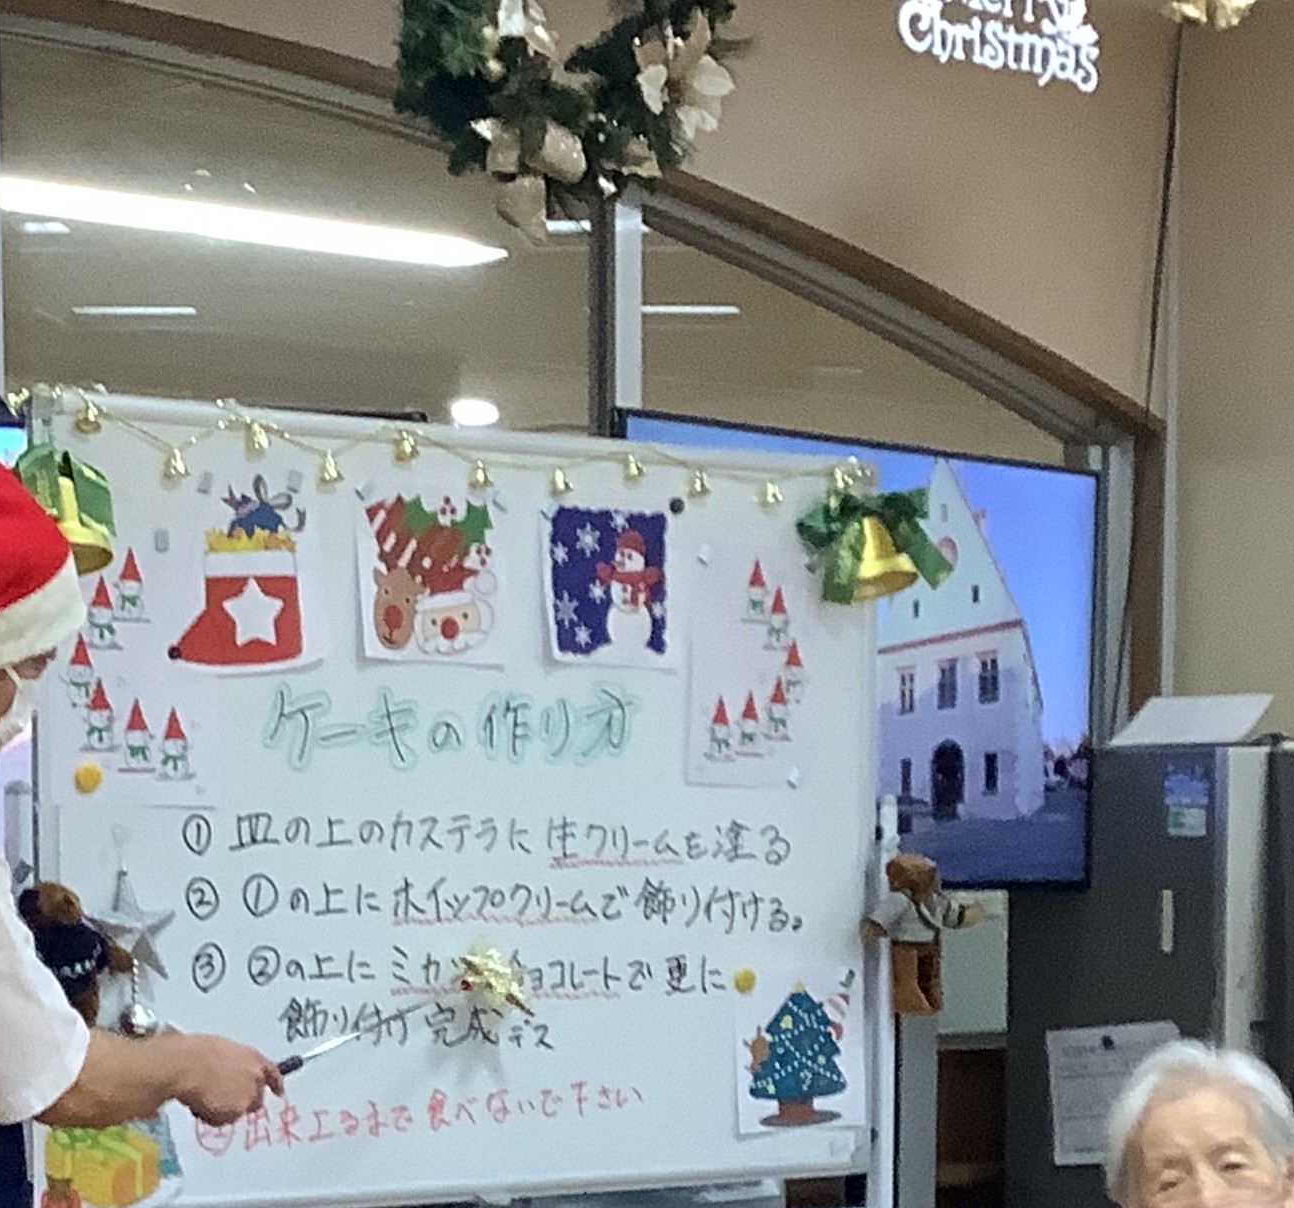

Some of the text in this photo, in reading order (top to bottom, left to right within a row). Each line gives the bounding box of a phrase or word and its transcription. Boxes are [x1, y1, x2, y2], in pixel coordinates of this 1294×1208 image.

[898, 0, 1100, 93] Christmas
[267, 687, 635, 764] ケーキの作り方
